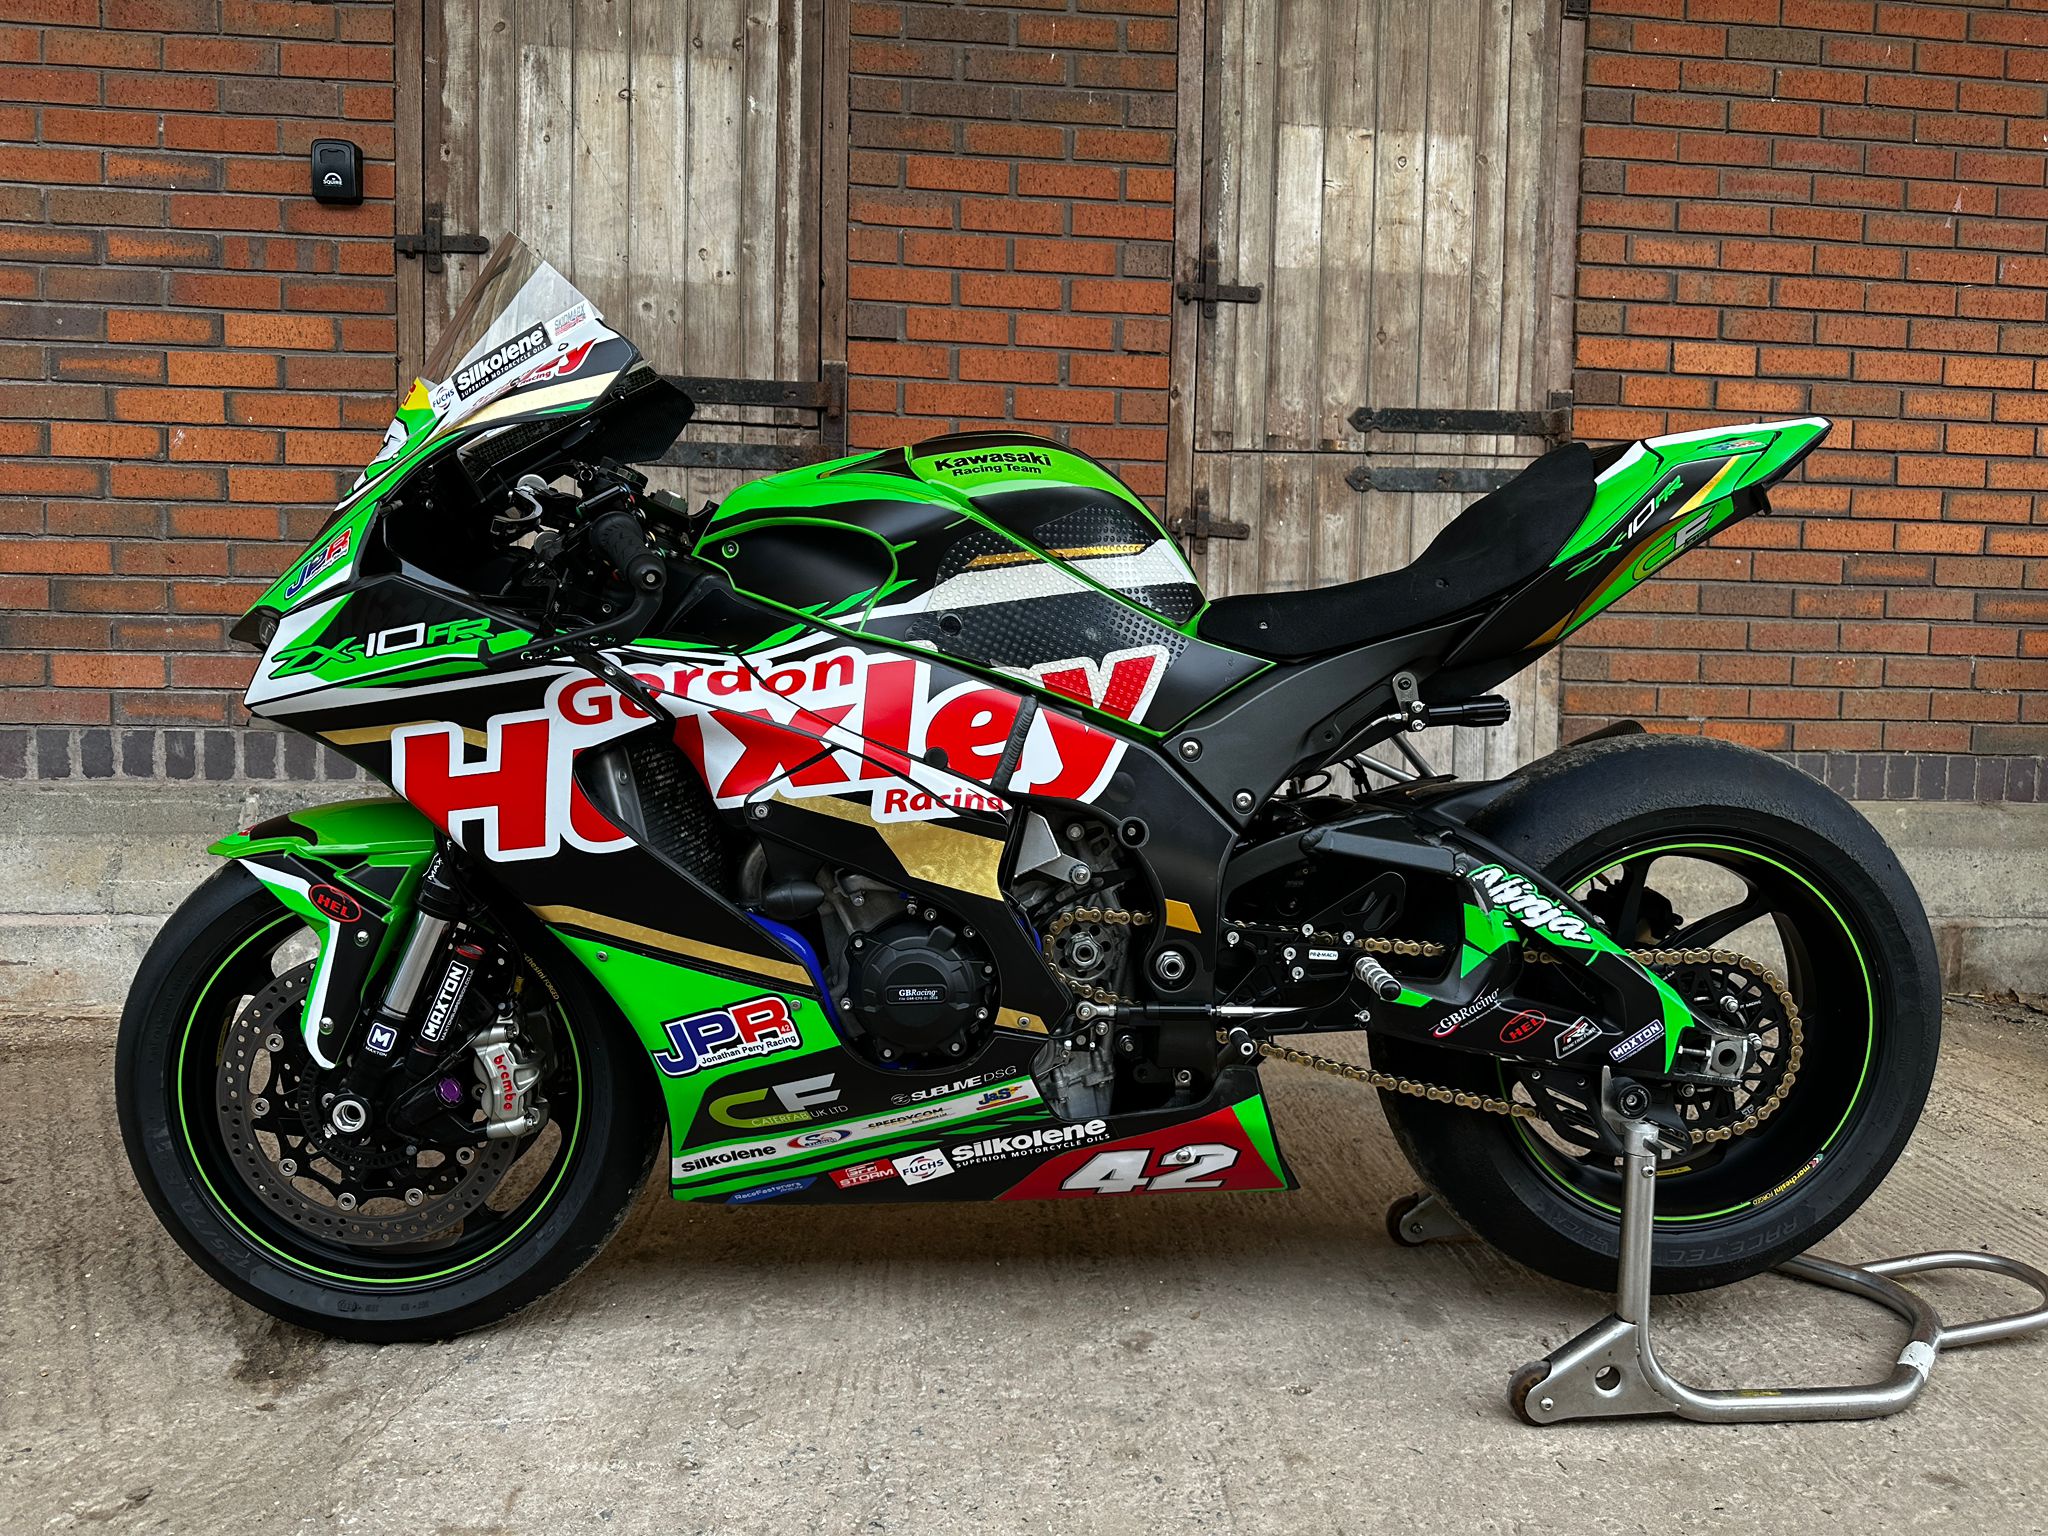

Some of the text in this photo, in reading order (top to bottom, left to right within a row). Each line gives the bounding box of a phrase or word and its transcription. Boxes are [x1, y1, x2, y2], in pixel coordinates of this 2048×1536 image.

[461, 342, 547, 399] SUPERIOR MOTORCYCLE OILS
[432, 389, 455, 408] FUCHS
[934, 452, 1052, 471] Kawasaki
[952, 464, 1041, 477] Racing Team
[557, 655, 855, 726] Gordon
[317, 894, 350, 919] HEL
[1472, 867, 1592, 942] Ninja
[543, 976, 560, 1000] FORGED
[899, 989, 936, 998] GBRacing
[425, 962, 466, 1039] MAXTON
[372, 1028, 391, 1047] M
[656, 999, 791, 1074] JPR
[780, 1024, 791, 1034] 42
[1509, 1017, 1545, 1040] HEL
[1613, 1022, 1660, 1058] MAXTON
[365, 1046, 388, 1057] MAXTON
[701, 1035, 797, 1065] Jonathan Perry Racing
[493, 1054, 514, 1111] brembo
[911, 1065, 1017, 1102] SUBLIME DSG
[751, 1105, 849, 1127] CATERFAB UK LTD
[867, 1107, 944, 1130] SPEEDYCOM
[956, 1133, 1111, 1169] SUPERIOR MOTORCYCLE OILS
[840, 1168, 894, 1186] STORM
[902, 1159, 945, 1176] FUCHS
[1061, 1143, 1239, 1194] 42
[734, 1181, 802, 1201] RaceFasteners
[1752, 1163, 1811, 1206] marchesini FORGED
[1666, 1215, 1798, 1262] RACETEC
